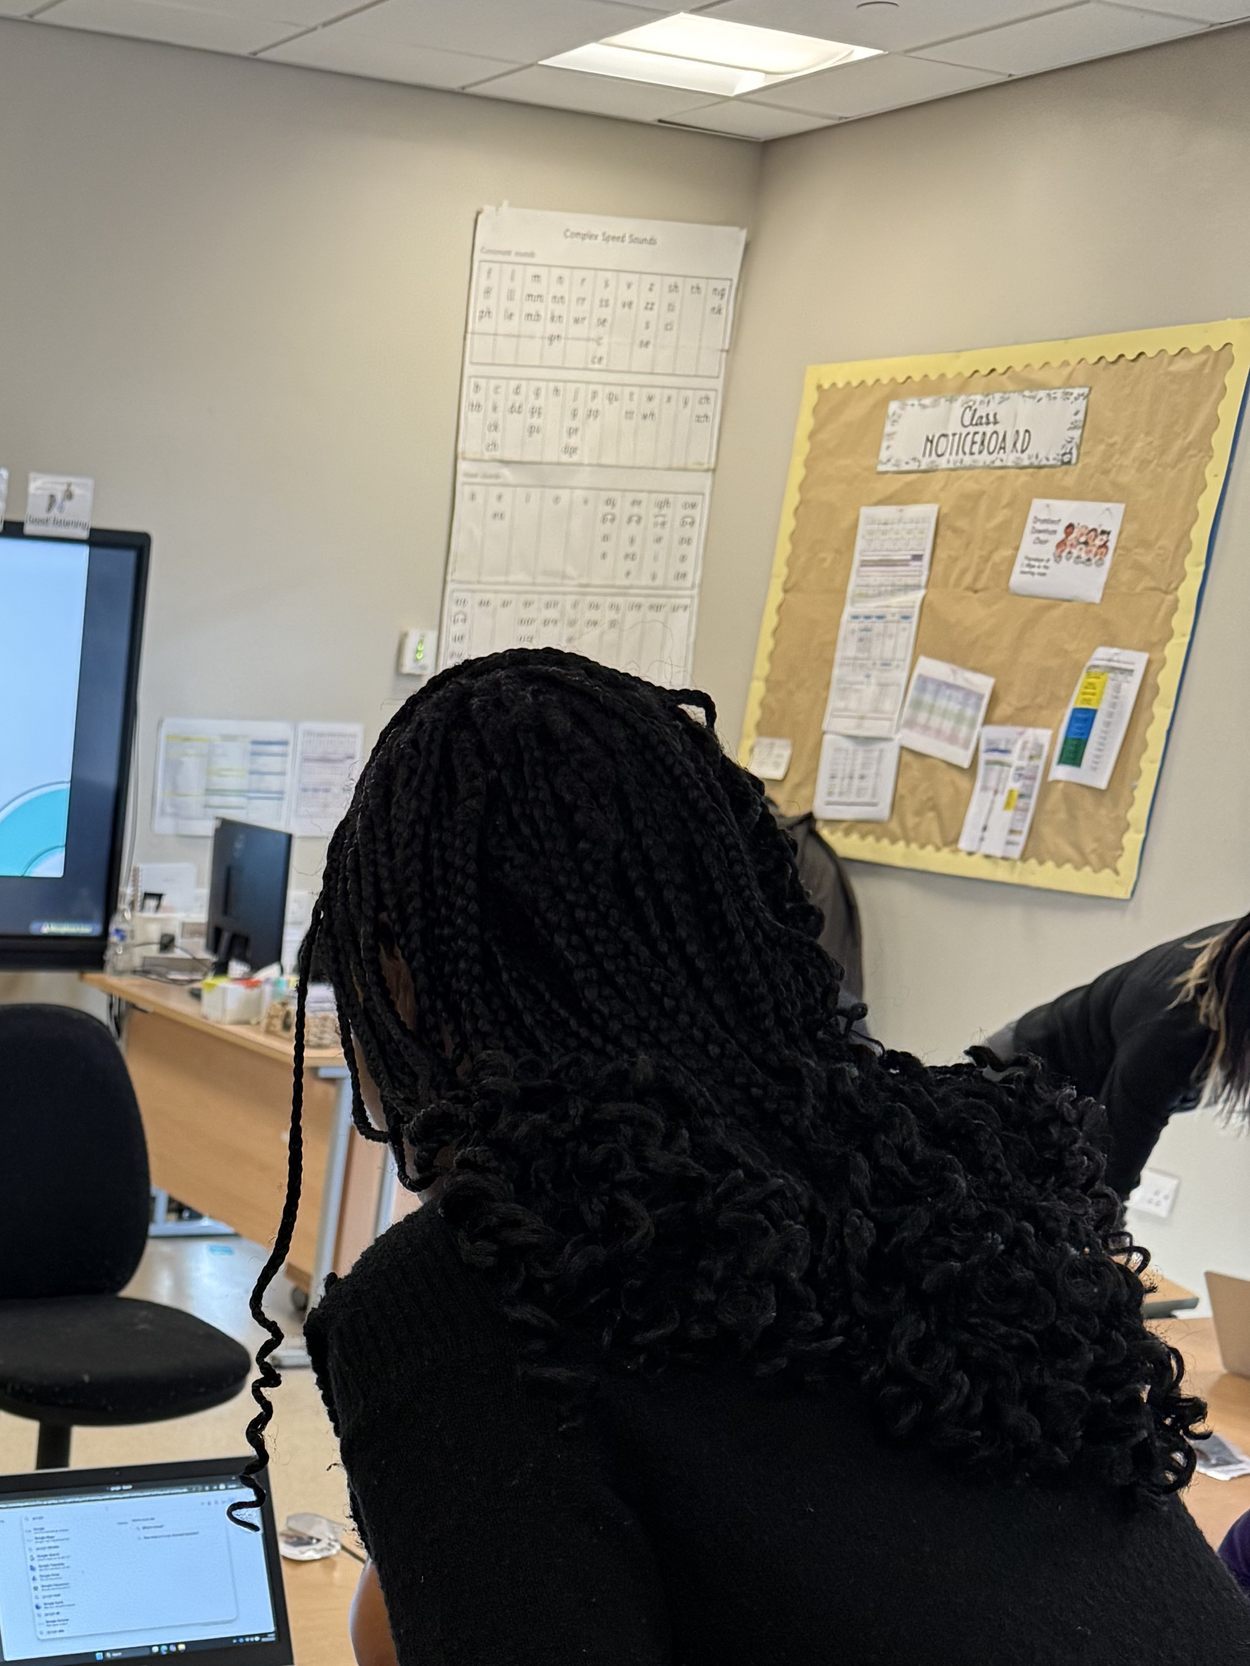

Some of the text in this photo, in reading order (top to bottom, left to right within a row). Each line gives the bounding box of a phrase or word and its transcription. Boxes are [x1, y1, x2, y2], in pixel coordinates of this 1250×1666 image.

[628, 234, 658, 246] Sounds
[960, 404, 1000, 428] Class
[922, 429, 1031, 458] NOTICEBOARD
